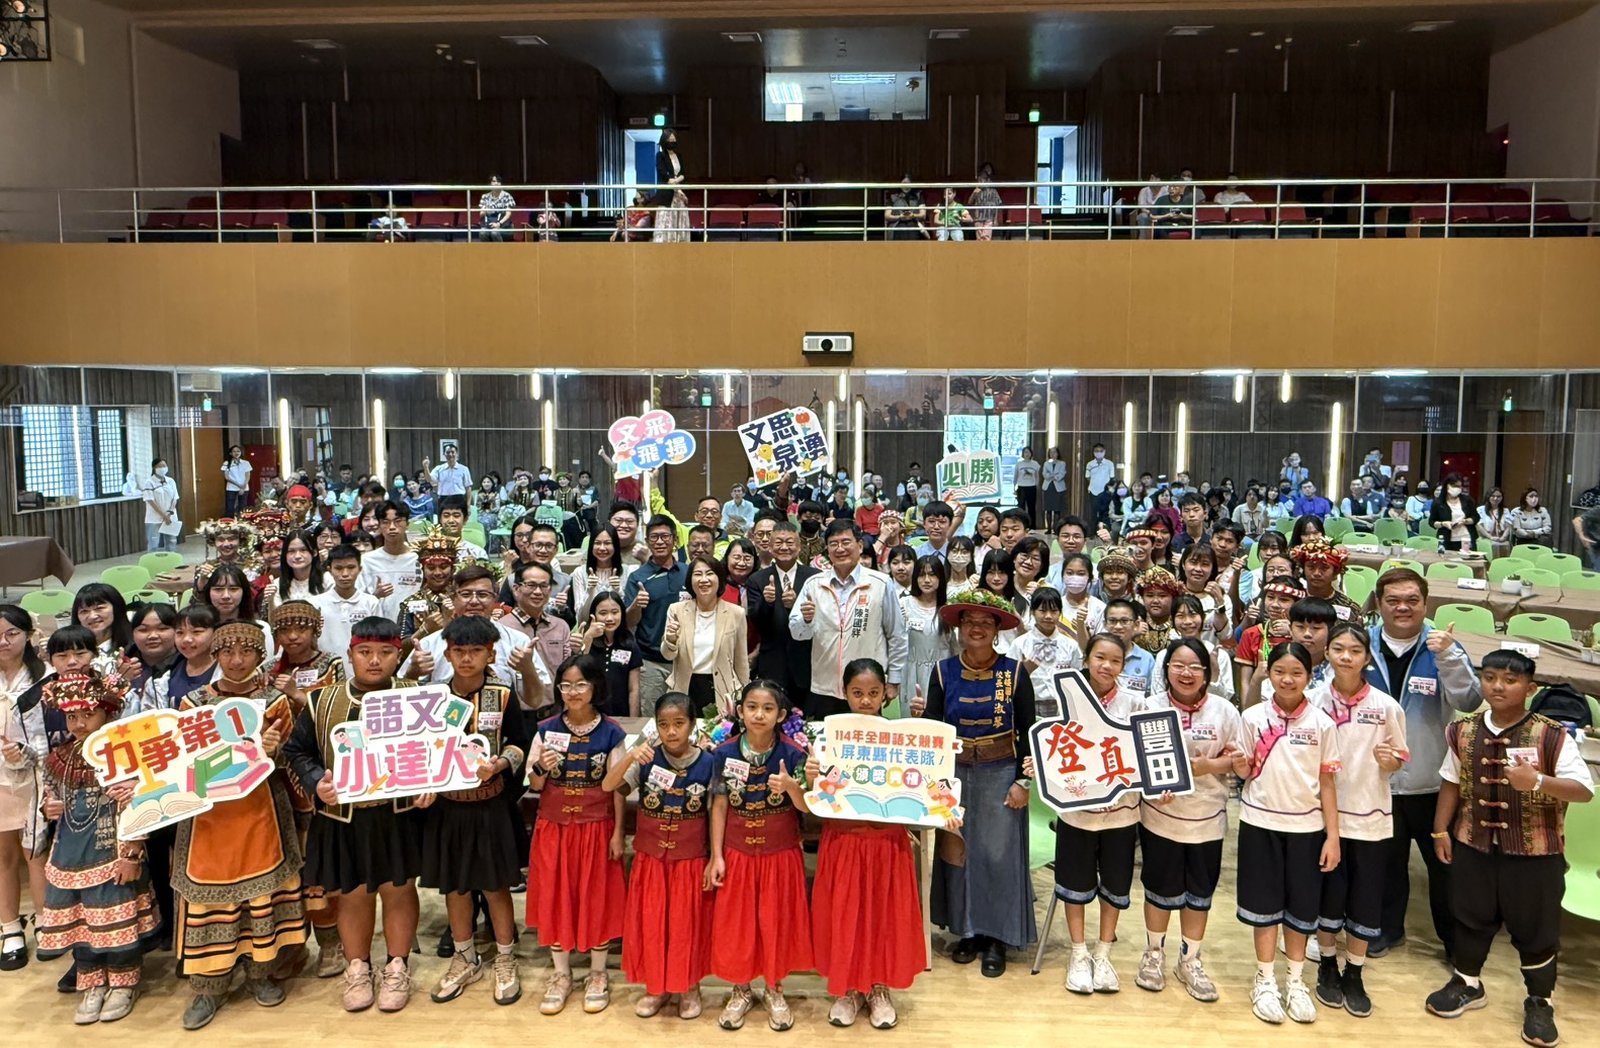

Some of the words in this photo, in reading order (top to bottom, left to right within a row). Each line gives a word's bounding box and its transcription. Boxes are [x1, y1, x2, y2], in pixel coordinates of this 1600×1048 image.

[617, 415, 667, 442] 文采
[741, 411, 798, 452] 文思
[637, 436, 687, 464] 飛揚
[773, 432, 827, 473] 泉湧
[943, 458, 994, 486] 必勝
[365, 691, 447, 735] 語文
[448, 708, 459, 721] A
[96, 707, 246, 782] 力爭第1
[835, 729, 945, 750] 114年全國語文競賽
[840, 743, 936, 766] 屏東縣代表隊
[1045, 720, 1136, 787] 登真
[335, 735, 478, 793] 小達人
